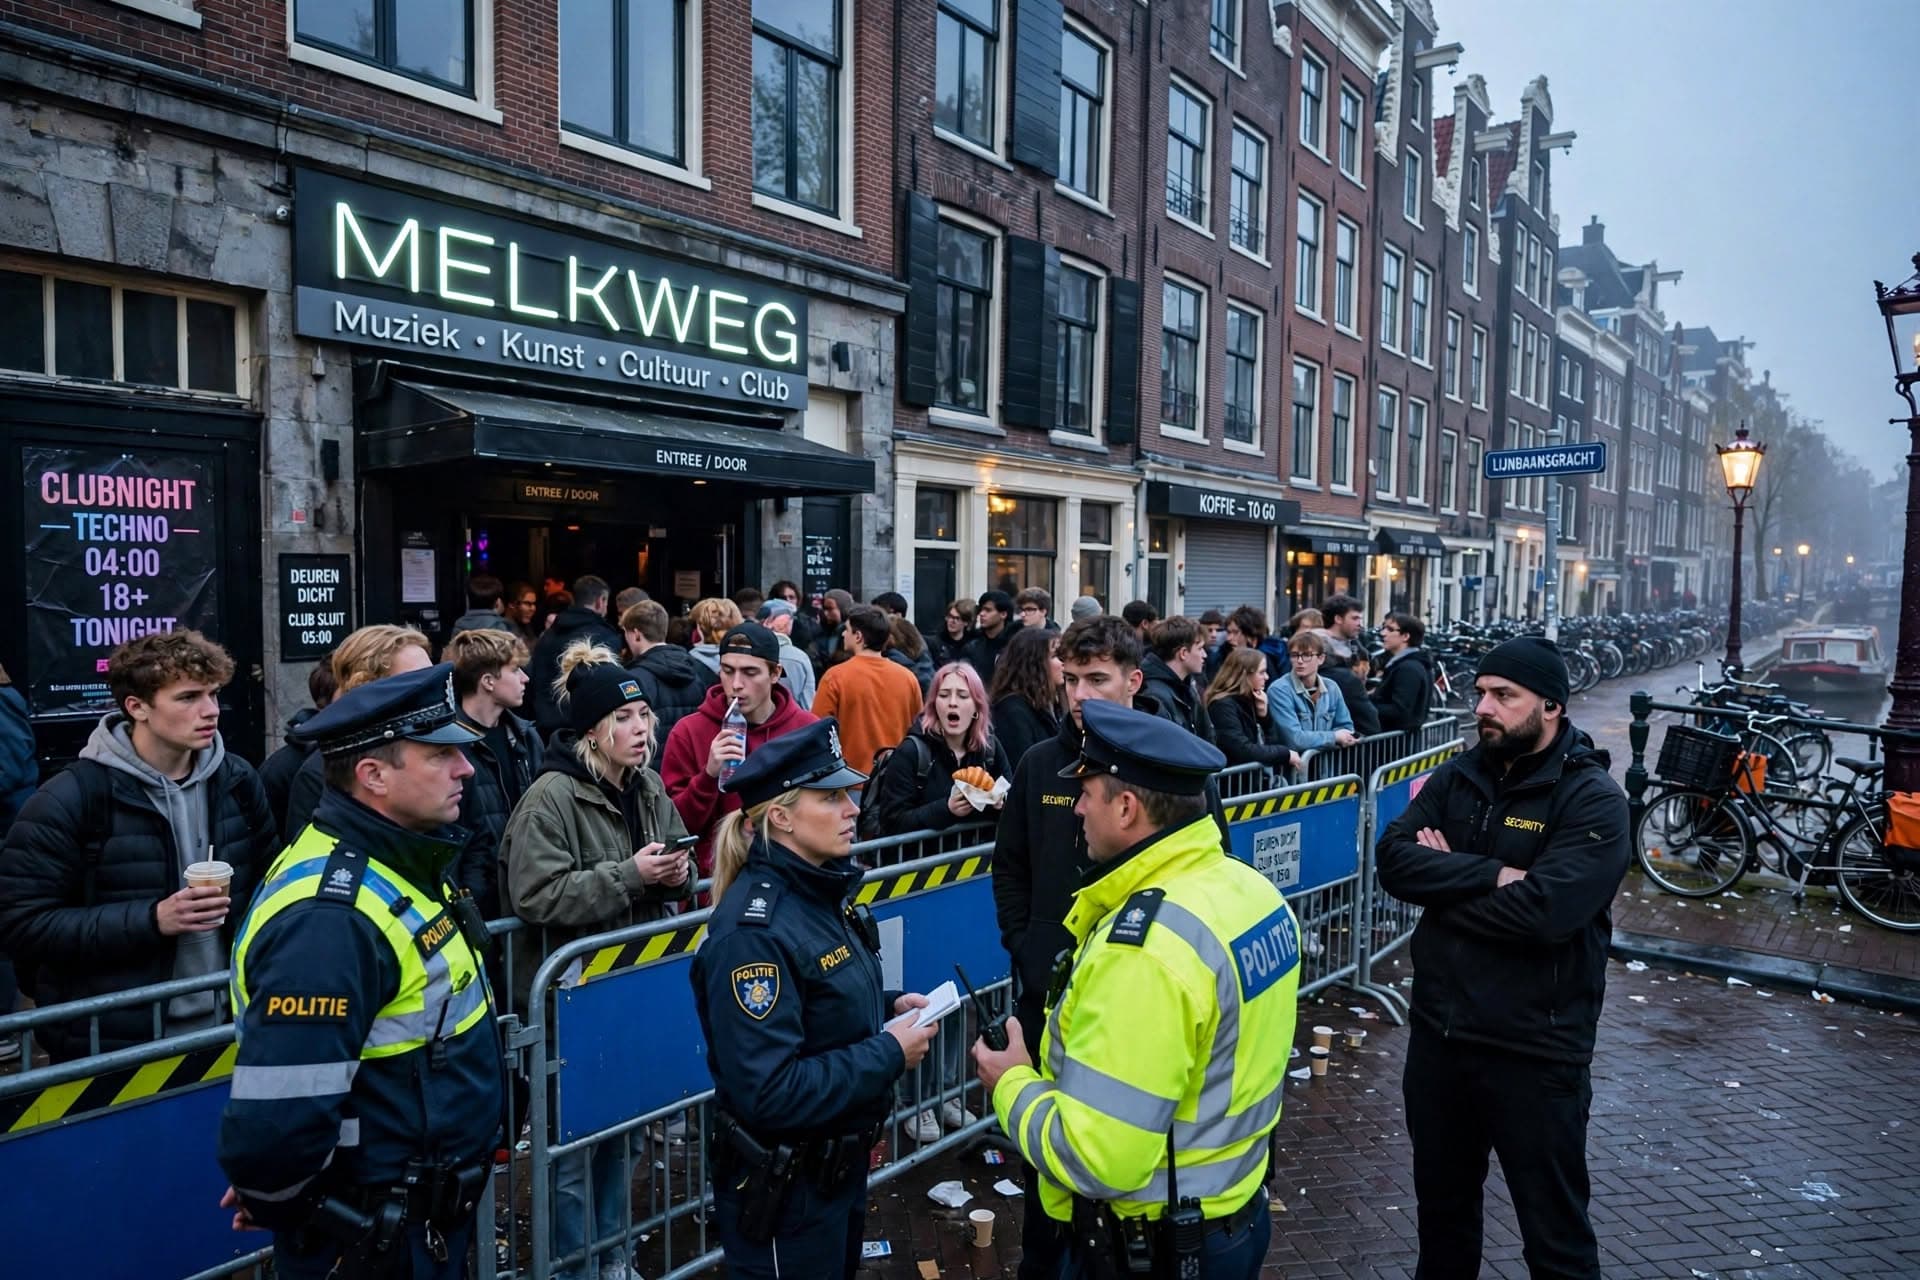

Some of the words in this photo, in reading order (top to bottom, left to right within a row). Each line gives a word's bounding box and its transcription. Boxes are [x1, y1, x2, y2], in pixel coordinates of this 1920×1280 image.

[335, 201, 799, 365] MELKWEG
[335, 300, 460, 349] Muziek
[502, 329, 585, 368] Kunst
[619, 350, 711, 388] Cultuur
[741, 371, 789, 401] Club
[656, 449, 703, 468] ENTREE
[714, 456, 747, 471] DOOR
[1492, 451, 1596, 472] LIJNBAANSGRACHT
[41, 471, 196, 510] CLUBNIGHT
[525, 485, 562, 499] ENTREE
[571, 489, 599, 500] DOOR
[1200, 494, 1236, 516] KOFFIE
[1248, 501, 1260, 519] TO
[1262, 503, 1276, 520] GO
[72, 512, 169, 543] TECHNO
[85, 547, 160, 577] 04:00
[290, 568, 340, 584] DEUREN
[100, 583, 149, 611] 18+
[297, 587, 335, 603] DICHT
[288, 613, 315, 627] CLUB
[317, 612, 346, 626] SLUIT
[70, 617, 176, 647] TONIGHT
[301, 630, 333, 644] 05:00
[1042, 794, 1075, 807] SECURITY
[1504, 816, 1547, 833] SECURITY
[421, 915, 454, 951] POLITIE
[820, 944, 851, 972] POLITIE
[1239, 914, 1298, 987] POLITIE
[736, 966, 775, 983] POLITIE
[267, 996, 348, 1017] POLITIE
